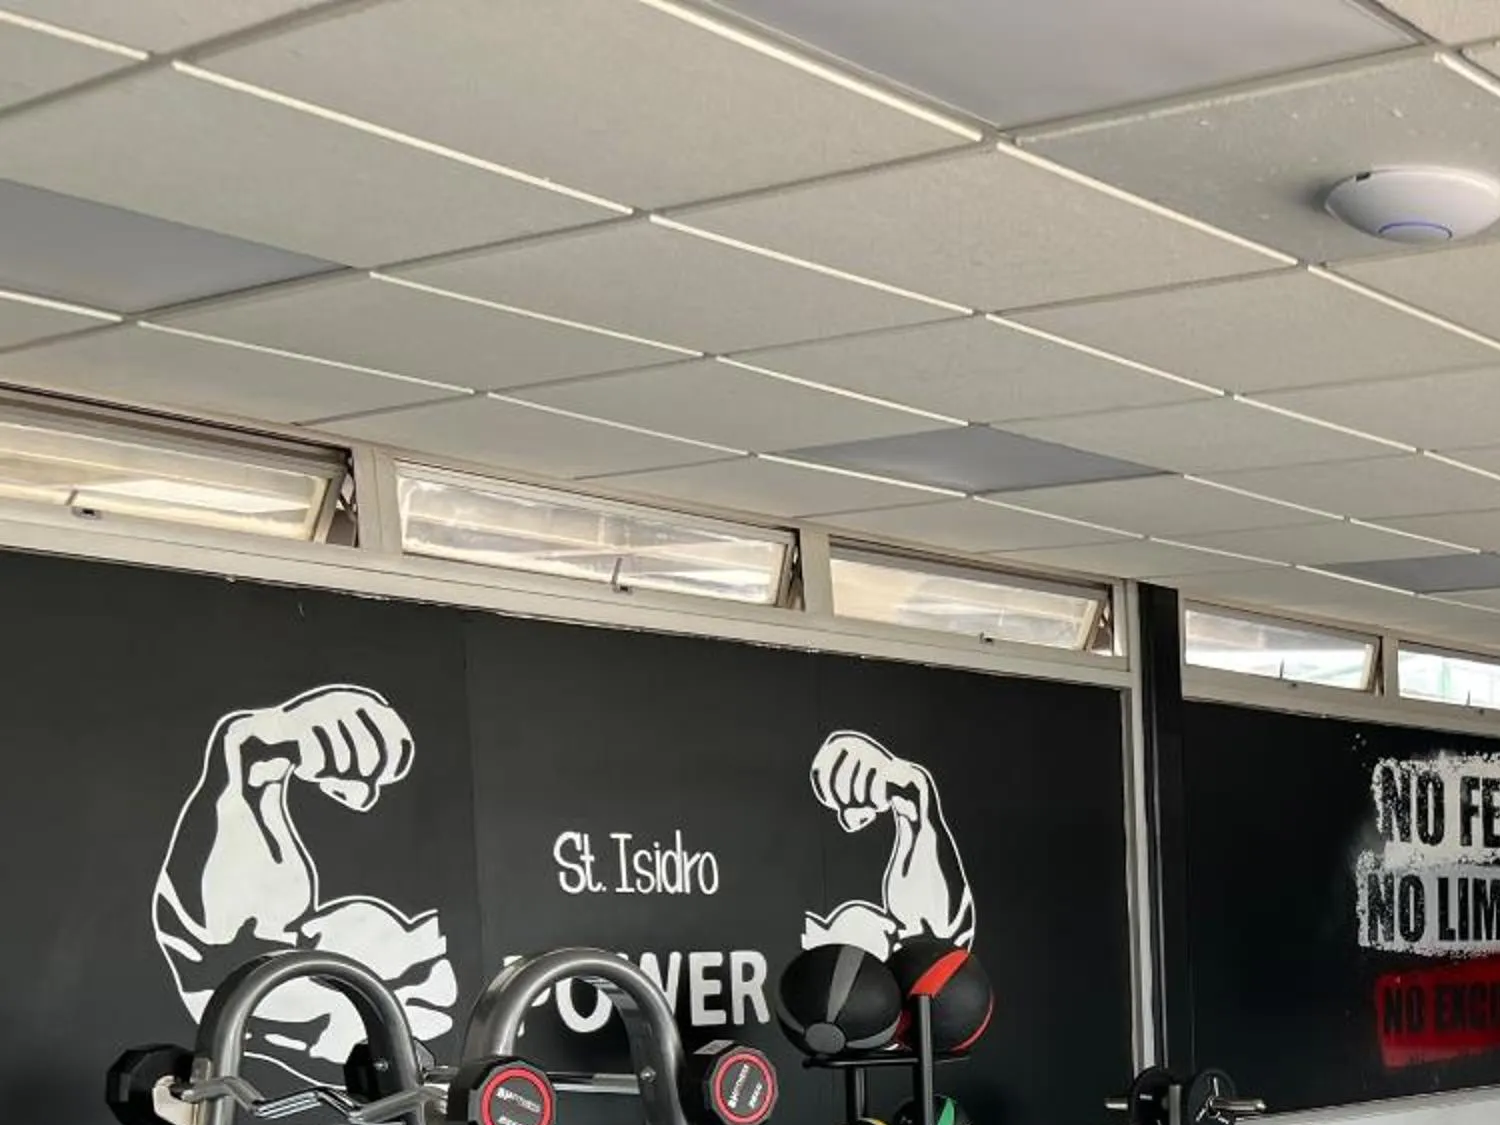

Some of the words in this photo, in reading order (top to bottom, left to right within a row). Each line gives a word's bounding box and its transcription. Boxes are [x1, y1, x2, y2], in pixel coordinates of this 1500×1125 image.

[1381, 766, 1445, 846] NO
[553, 831, 607, 894] St.
[610, 829, 719, 895] Isidro
[1367, 873, 1426, 943] NO
[1384, 984, 1425, 1033] NO
